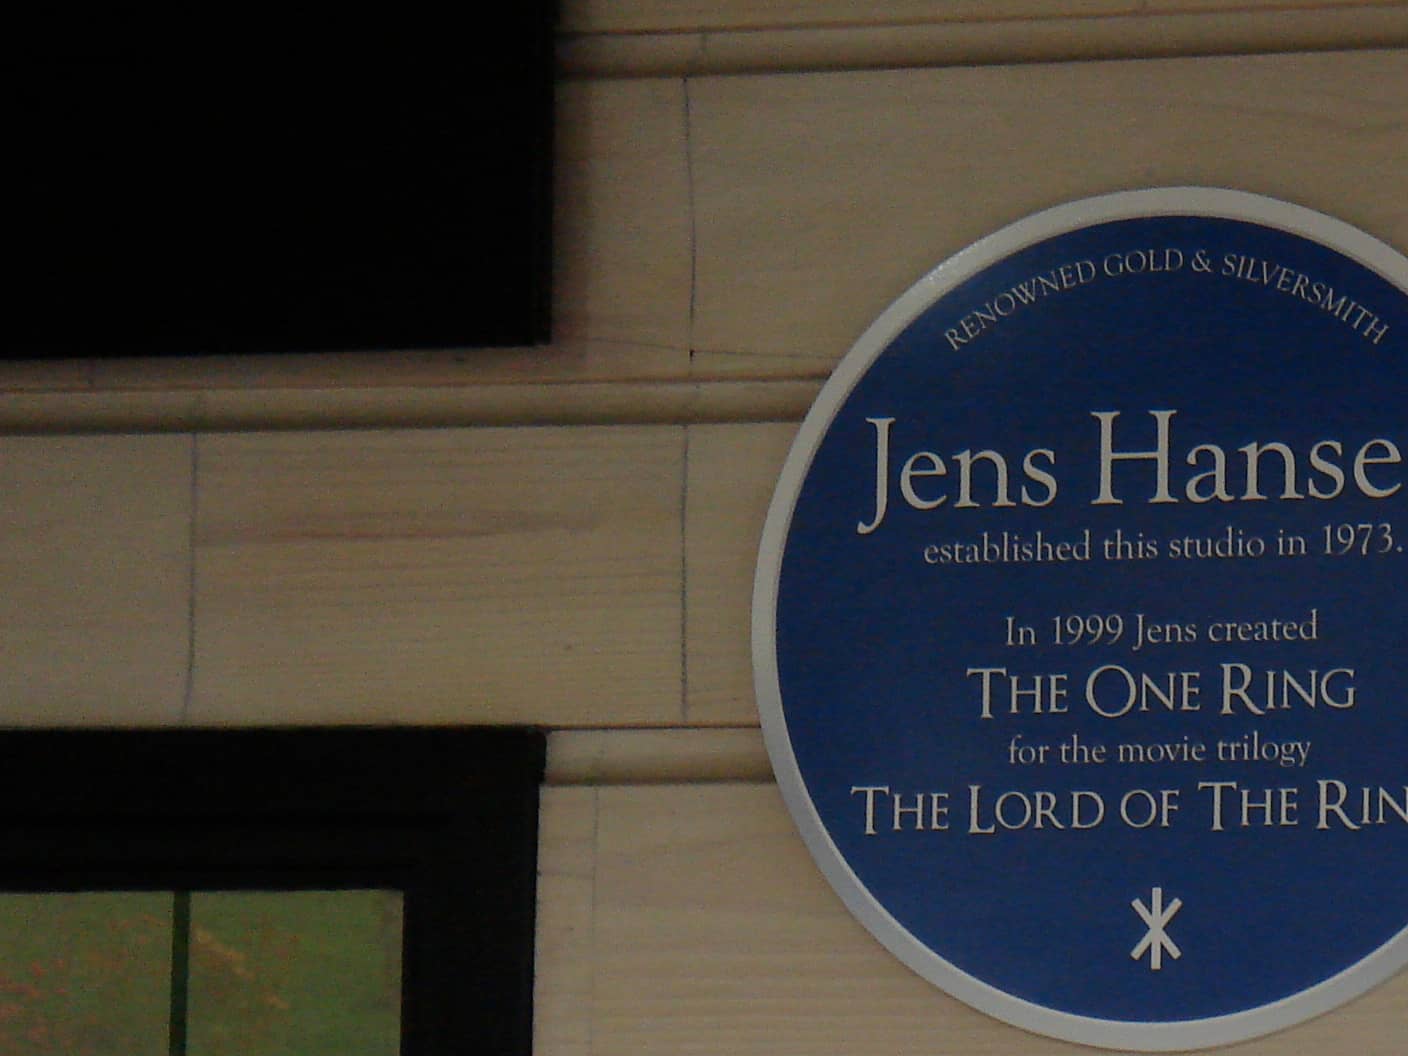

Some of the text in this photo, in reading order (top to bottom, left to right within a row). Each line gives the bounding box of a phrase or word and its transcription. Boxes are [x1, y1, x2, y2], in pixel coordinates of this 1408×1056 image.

[943, 248, 1391, 351] RENOWNED GOLD & SILVERSMITH
[856, 417, 1058, 536] Jens
[924, 523, 1403, 564] established this studio in 1973.
[1006, 608, 1317, 651] In 1999 Jens created
[966, 663, 1355, 719] THE ONE RING
[1009, 731, 1311, 767] for the movie trilogy
[850, 785, 949, 835] THE
[968, 784, 1105, 834] LORD
[1120, 789, 1180, 828] OF
[1197, 781, 1298, 831] THE
